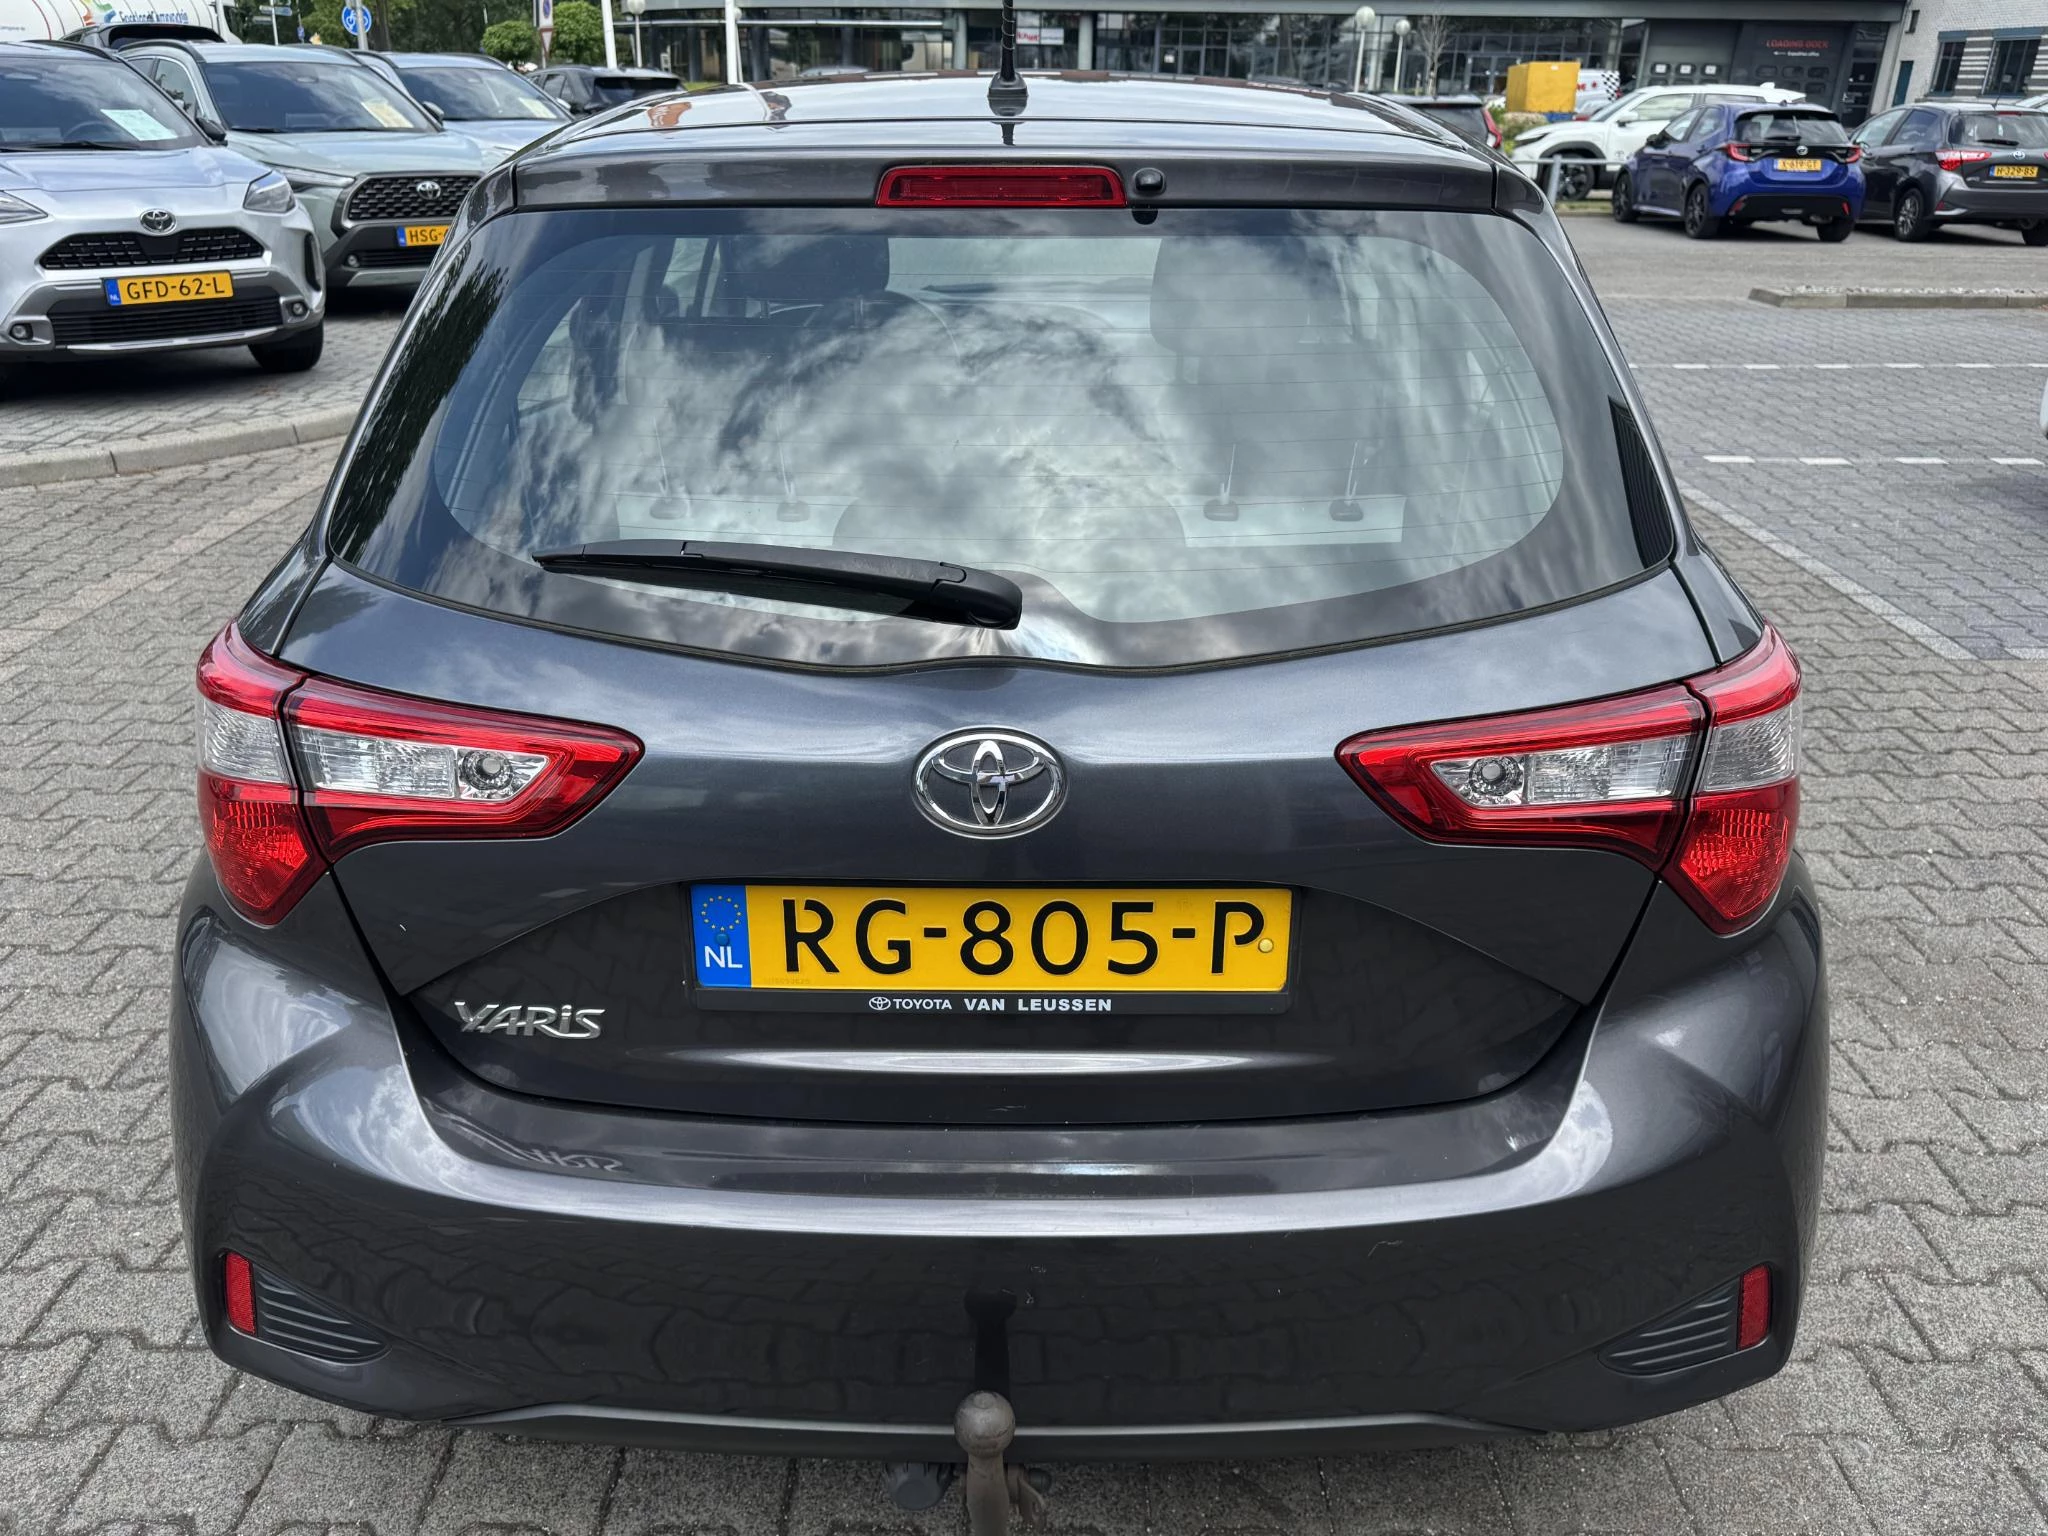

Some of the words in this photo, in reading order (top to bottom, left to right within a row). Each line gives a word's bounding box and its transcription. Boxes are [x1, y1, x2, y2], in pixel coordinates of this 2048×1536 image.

[127, 277, 225, 300] GFD-62-L
[704, 945, 743, 968] NL
[783, 898, 1265, 975] RG-805-P
[893, 998, 953, 1010] TOYOTA
[964, 998, 1005, 1011] VAN
[1018, 998, 1112, 1011] LEUSSEN
